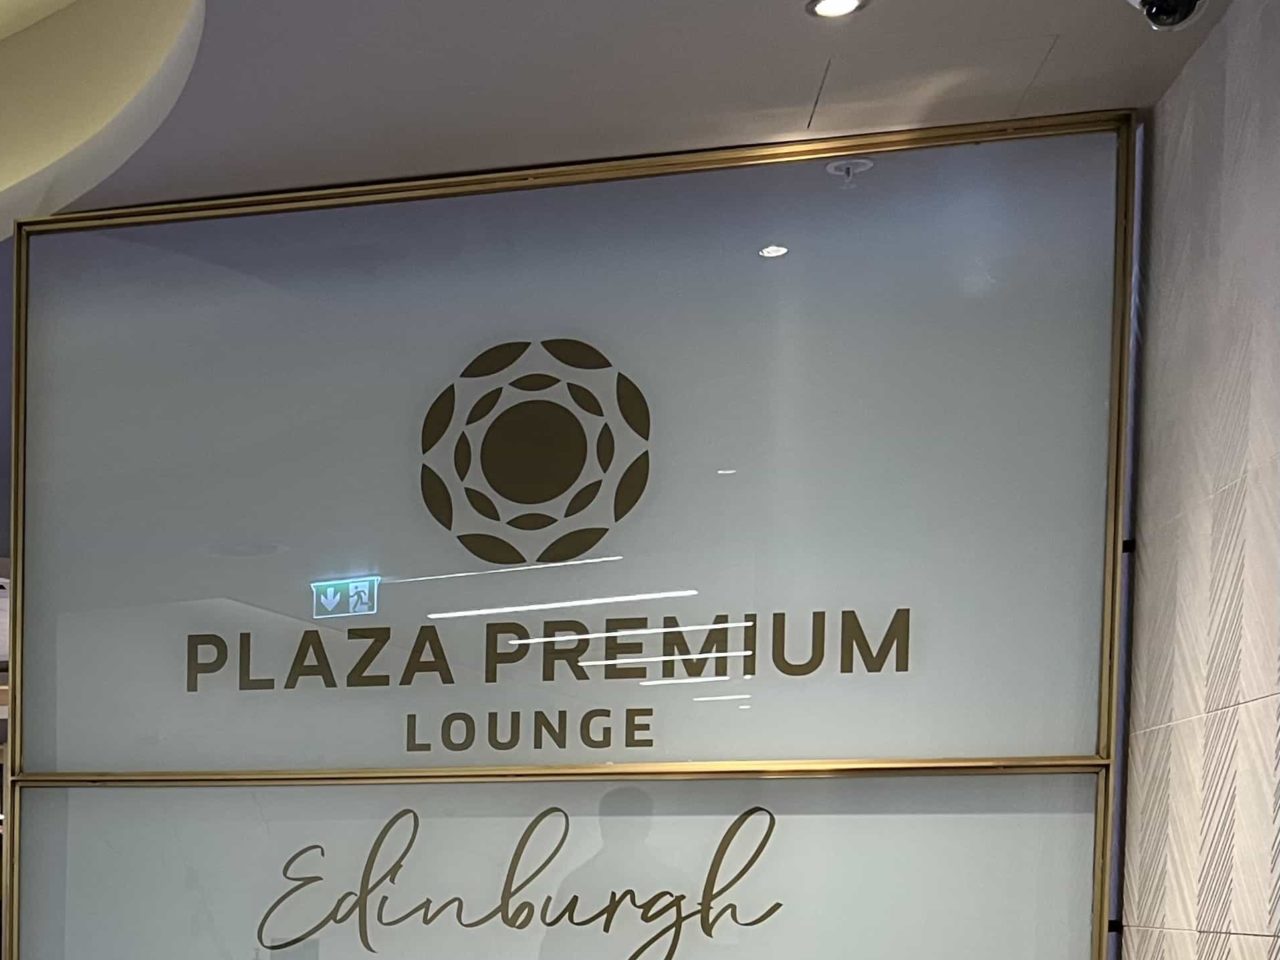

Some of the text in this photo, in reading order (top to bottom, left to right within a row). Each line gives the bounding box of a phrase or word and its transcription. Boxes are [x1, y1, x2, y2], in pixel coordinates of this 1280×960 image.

[186, 607, 910, 693] PLAZA PREMIUM
[405, 707, 655, 752] LOUNGE
